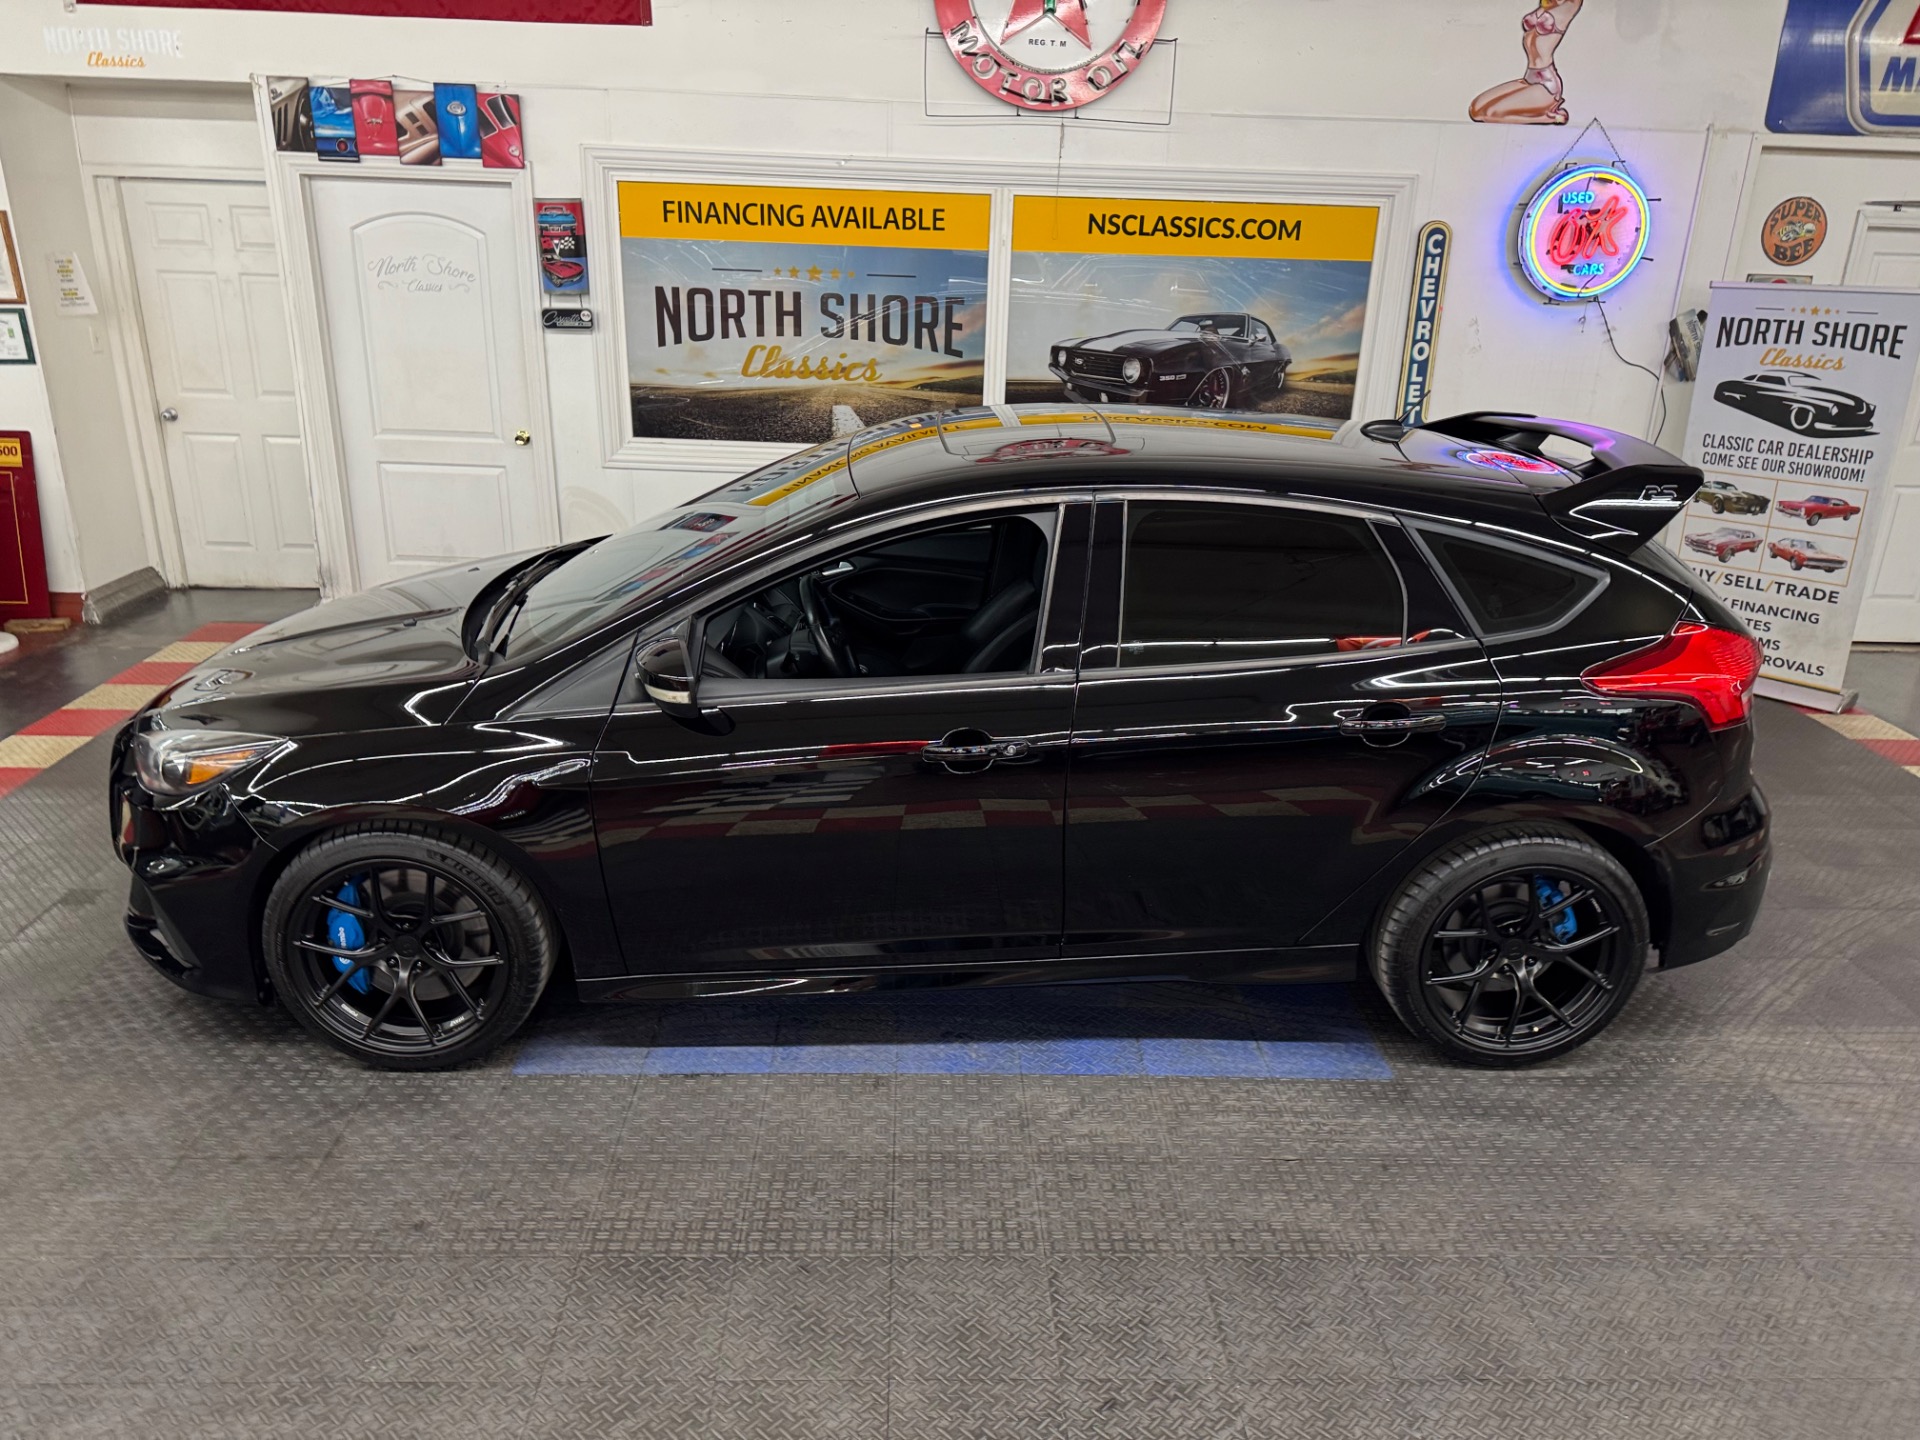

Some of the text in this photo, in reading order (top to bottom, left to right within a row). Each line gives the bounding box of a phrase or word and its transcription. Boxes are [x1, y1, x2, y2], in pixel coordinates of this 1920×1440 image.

[43, 26, 183, 58] NORTH SHORE
[87, 51, 146, 68] Classics
[950, 20, 1150, 106] MOTOR OIL
[1879, 56, 1920, 92] M
[1562, 191, 1595, 204] USED
[662, 200, 945, 232] FINANCING AVAILABLE
[1087, 213, 1302, 242] NSCLASSICS.COM
[1550, 195, 1629, 266] OK
[1769, 200, 1822, 236] SUPER
[1773, 238, 1815, 262] BEE
[367, 253, 476, 283] North Shore
[1572, 263, 1605, 275] CARS
[405, 278, 443, 292] Classics
[654, 285, 965, 359] NORTH SHORE
[1406, 233, 1444, 424] CHEVROLET
[1716, 316, 1908, 360] NORTH SHORE
[740, 344, 883, 382] Classics
[1759, 348, 1846, 371] Classics
[1702, 433, 1874, 466] CLASSIC CAR DEALERSHIP
[1702, 452, 1866, 483] COME SEE OUR SHOWROOM!
[1730, 598, 1820, 625] FINANCING
[1744, 617, 1772, 633] TES
[1762, 654, 1826, 677] ROVALS
